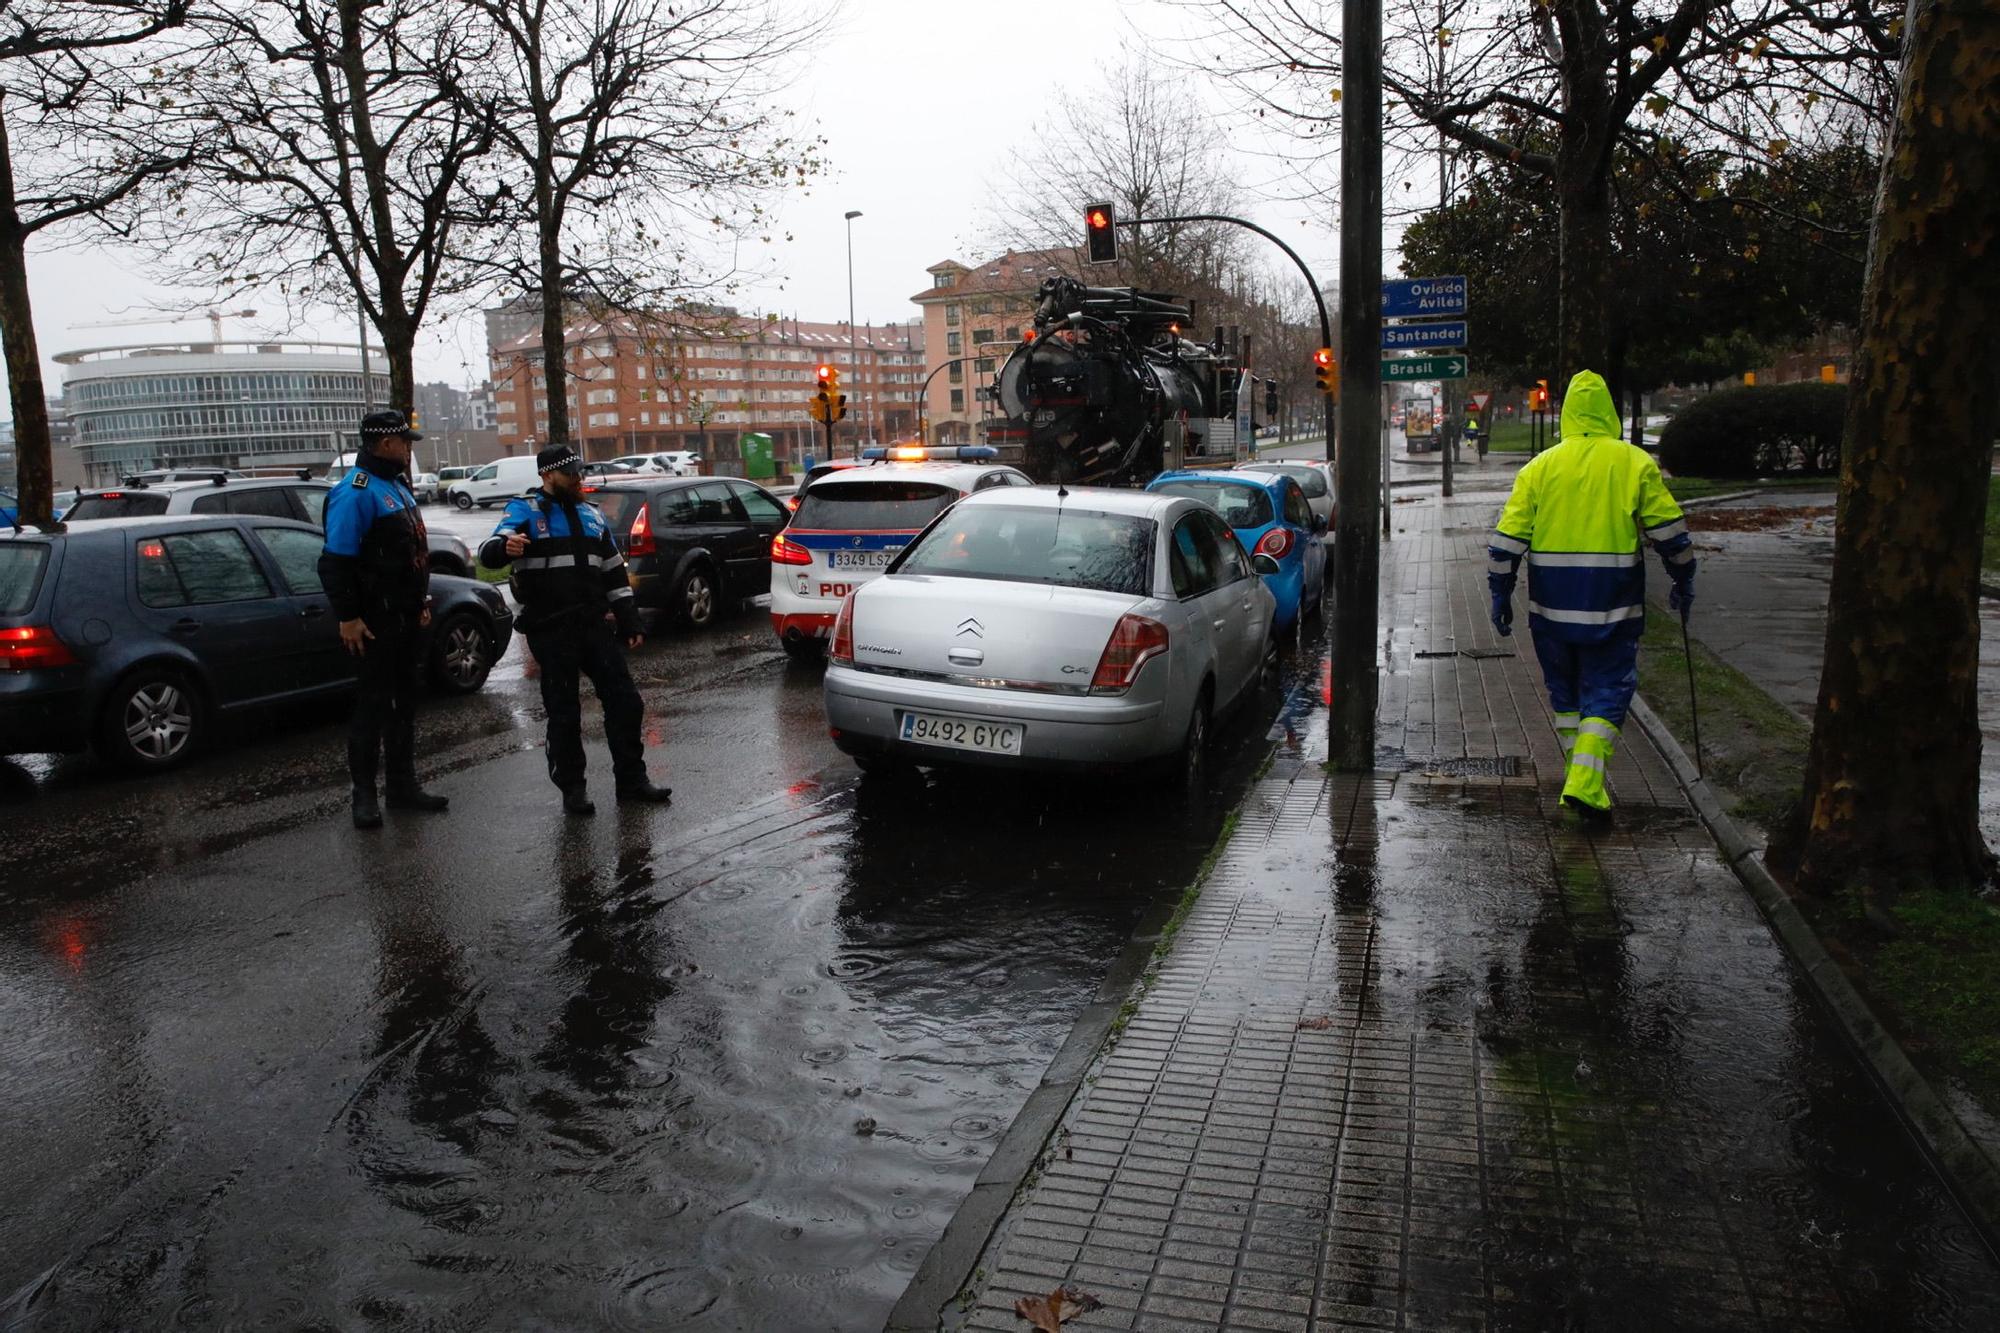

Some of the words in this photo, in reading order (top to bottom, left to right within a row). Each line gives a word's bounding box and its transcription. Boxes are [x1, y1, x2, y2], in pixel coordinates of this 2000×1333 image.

[1411, 282, 1463, 296] Oviedo
[1419, 296, 1463, 309] Avilés
[1387, 328, 1463, 343] Santander
[1390, 362, 1433, 375] Brasil
[836, 554, 865, 566] 3349
[868, 554, 891, 566] LSZ
[916, 719, 967, 744] 9492
[973, 725, 1014, 750] GYC
